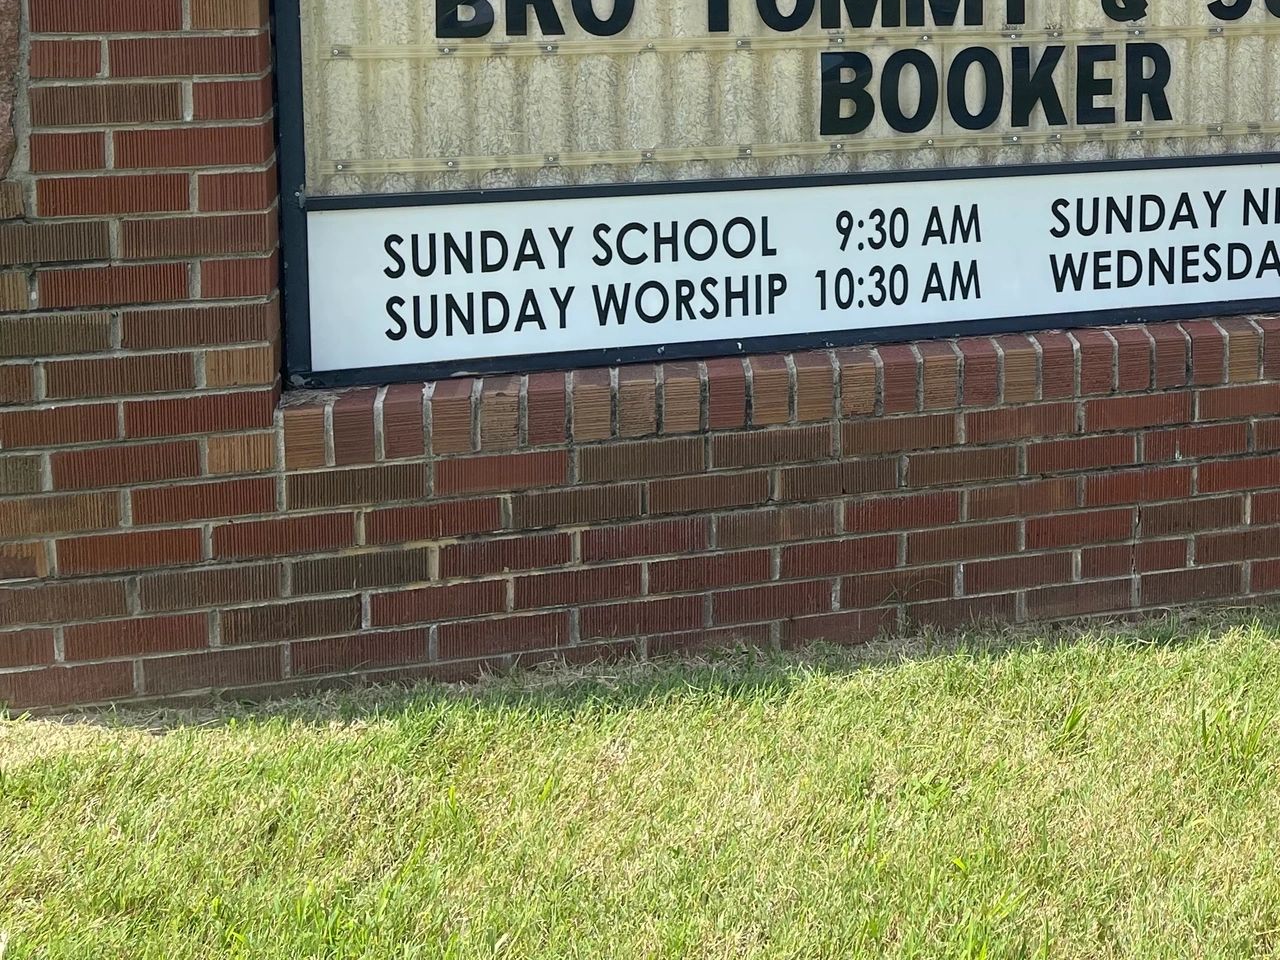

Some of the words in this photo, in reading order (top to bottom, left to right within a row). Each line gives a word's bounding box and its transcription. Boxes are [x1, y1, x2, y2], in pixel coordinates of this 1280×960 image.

[820, 43, 1173, 136] BOOKER
[384, 227, 573, 278] SUNDAY
[592, 216, 776, 266] SCHOOL
[836, 208, 908, 251] 9:30
[922, 204, 981, 245] AM
[1050, 190, 1226, 238] SUNDAY
[385, 286, 575, 340] SUNDAY
[592, 274, 786, 326] WORSHIP
[815, 264, 908, 310] 10:30
[922, 260, 980, 302] AM
